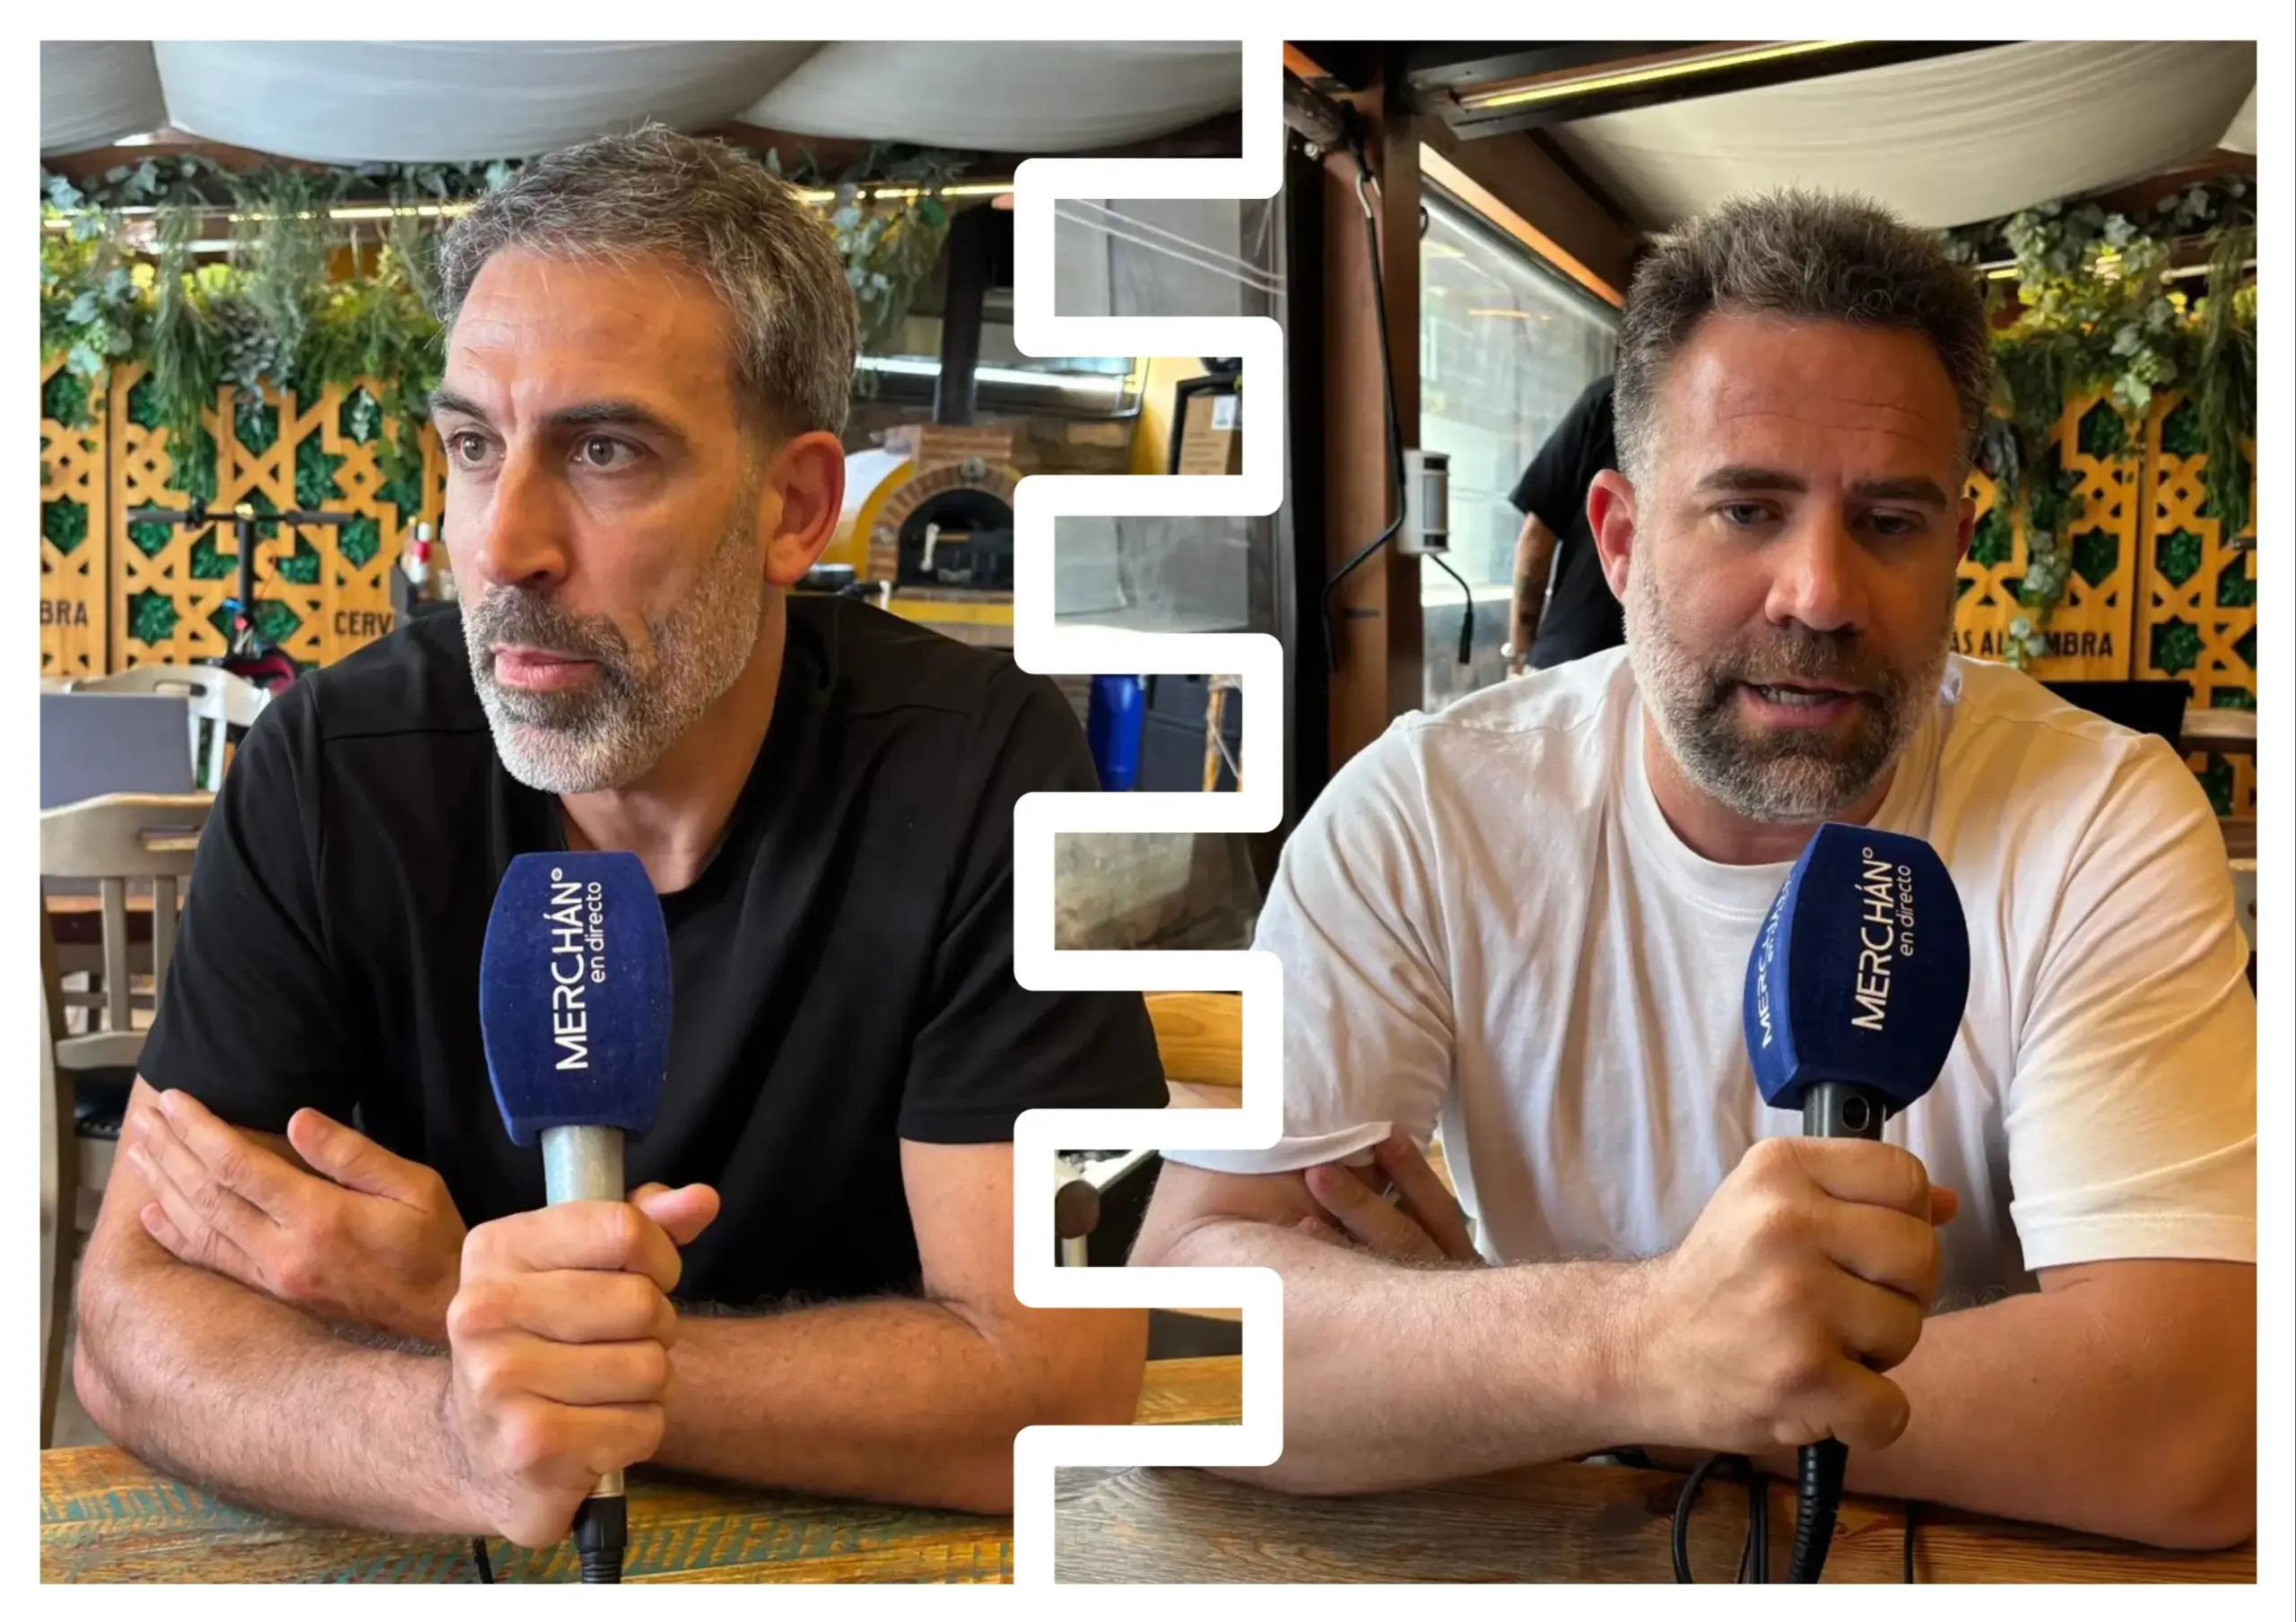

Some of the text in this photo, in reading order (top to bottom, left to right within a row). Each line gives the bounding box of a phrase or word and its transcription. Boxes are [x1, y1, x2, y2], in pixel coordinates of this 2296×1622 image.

[1980, 629, 2113, 657] ALMBRA
[585, 881, 605, 984] en directo
[1895, 865, 1914, 957] en directo
